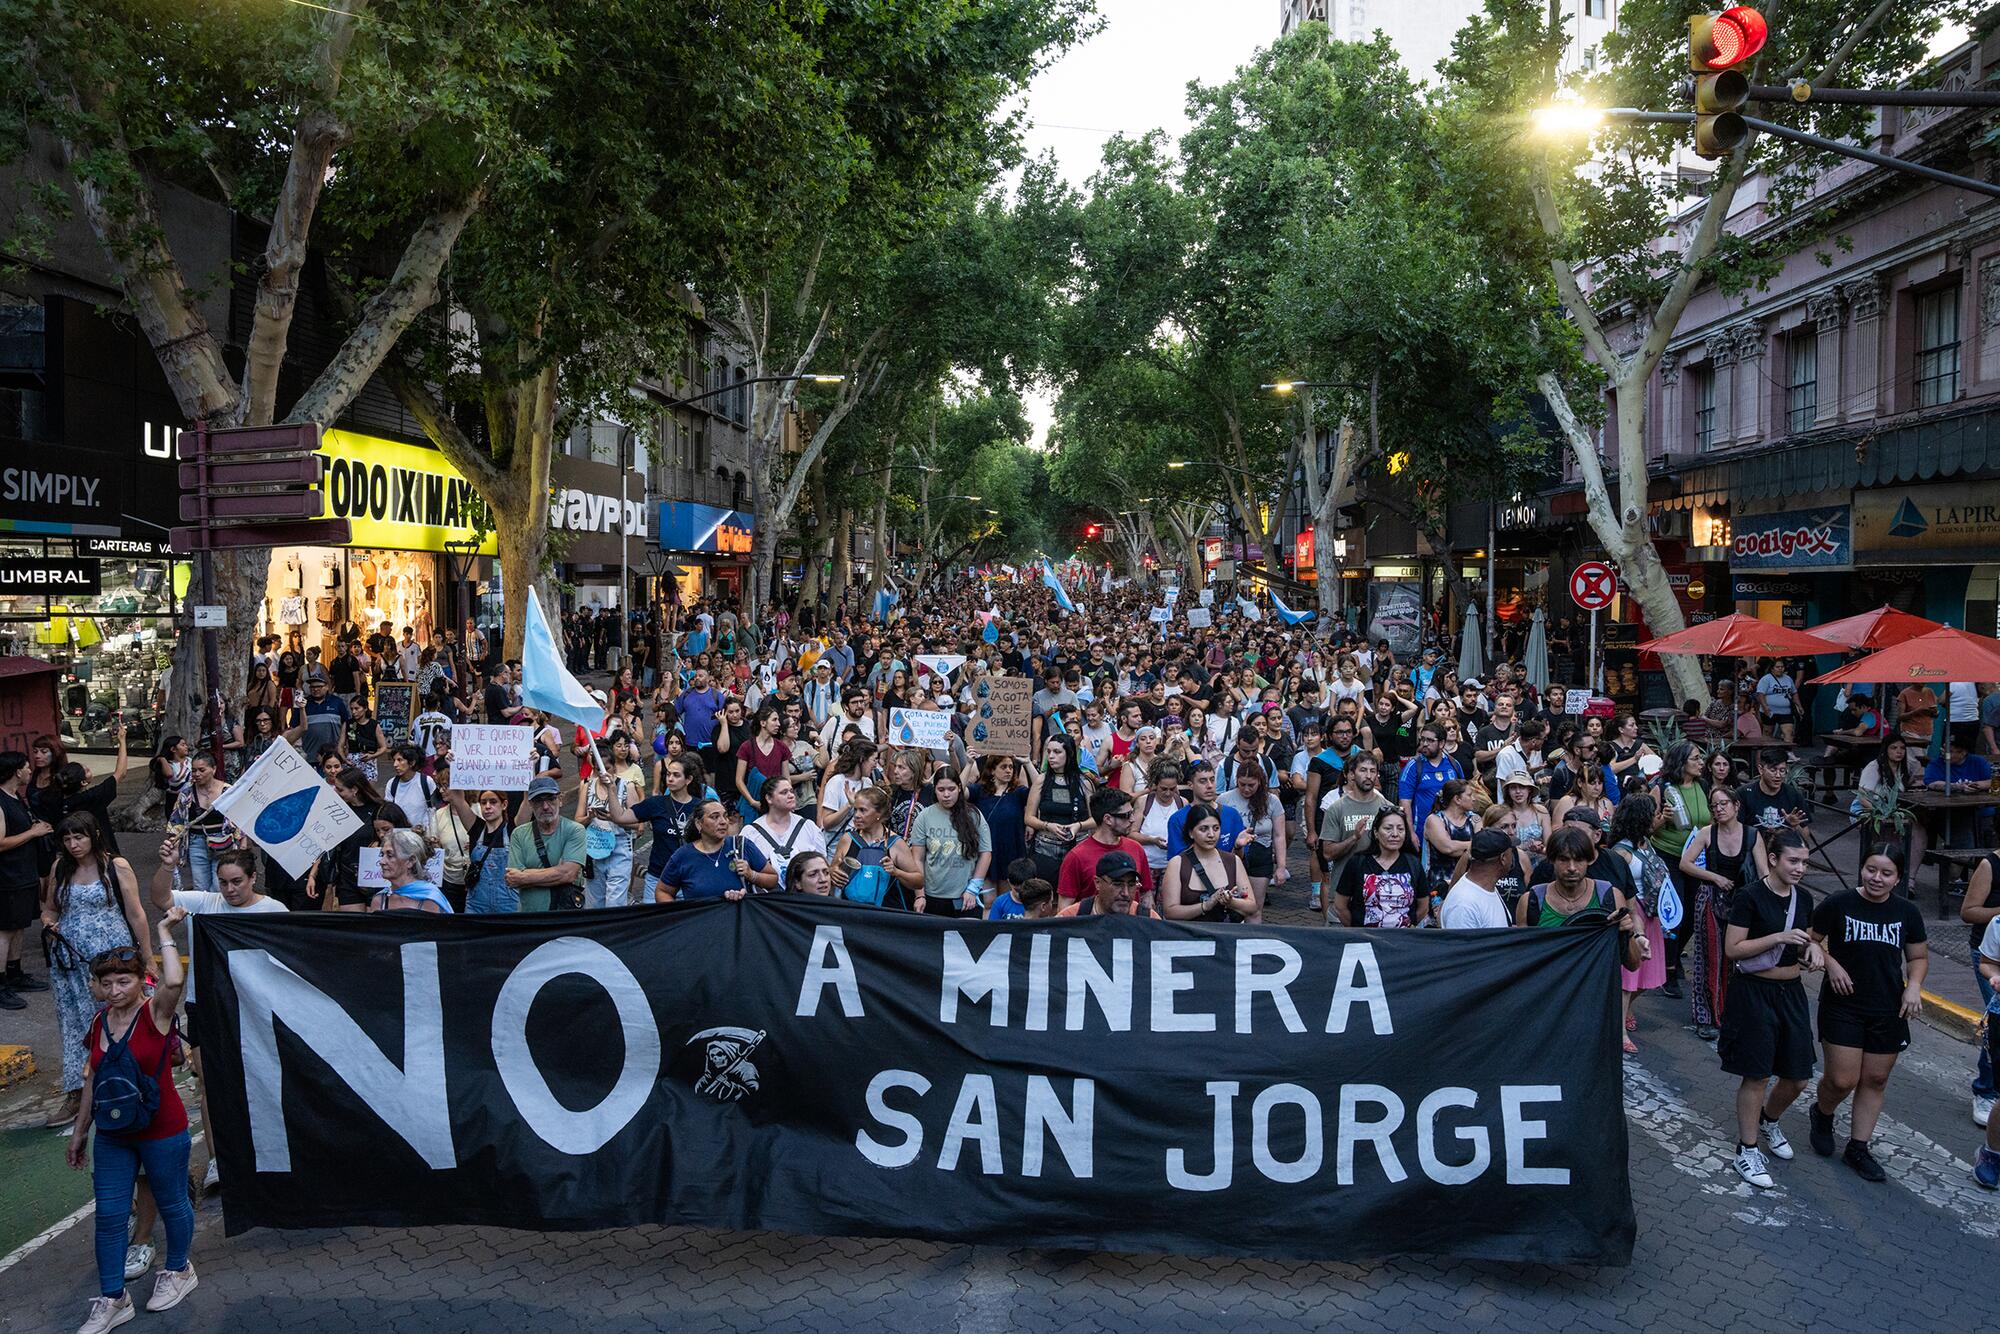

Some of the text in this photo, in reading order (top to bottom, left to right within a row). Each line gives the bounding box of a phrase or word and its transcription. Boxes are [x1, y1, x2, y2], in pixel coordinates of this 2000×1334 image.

[3, 467, 100, 507] SIMPLY.
[311, 453, 388, 521] TODO
[1501, 505, 1536, 528] LENNON
[1963, 506, 2000, 522] PIR
[90, 539, 152, 552] CARTERAS
[1, 569, 91, 583] UMBRAL
[1401, 567, 1420, 576] CLUB
[994, 680, 1028, 689] SOMOS
[1003, 692, 1030, 701] GOTA
[905, 711, 923, 720] GOTA
[457, 728, 524, 741] NO TE QUIERO
[1005, 730, 1029, 739] VASO
[464, 744, 483, 755] VER
[273, 750, 302, 774] LEY
[495, 760, 507, 770] NO
[477, 775, 495, 787] QUE
[323, 800, 350, 826] 7722
[310, 820, 326, 834] NO
[1844, 915, 1902, 948] EVERLAST
[795, 925, 1394, 1036] A MINERA
[227, 936, 661, 1172] NO
[855, 1069, 1571, 1193] SAN JORGE
